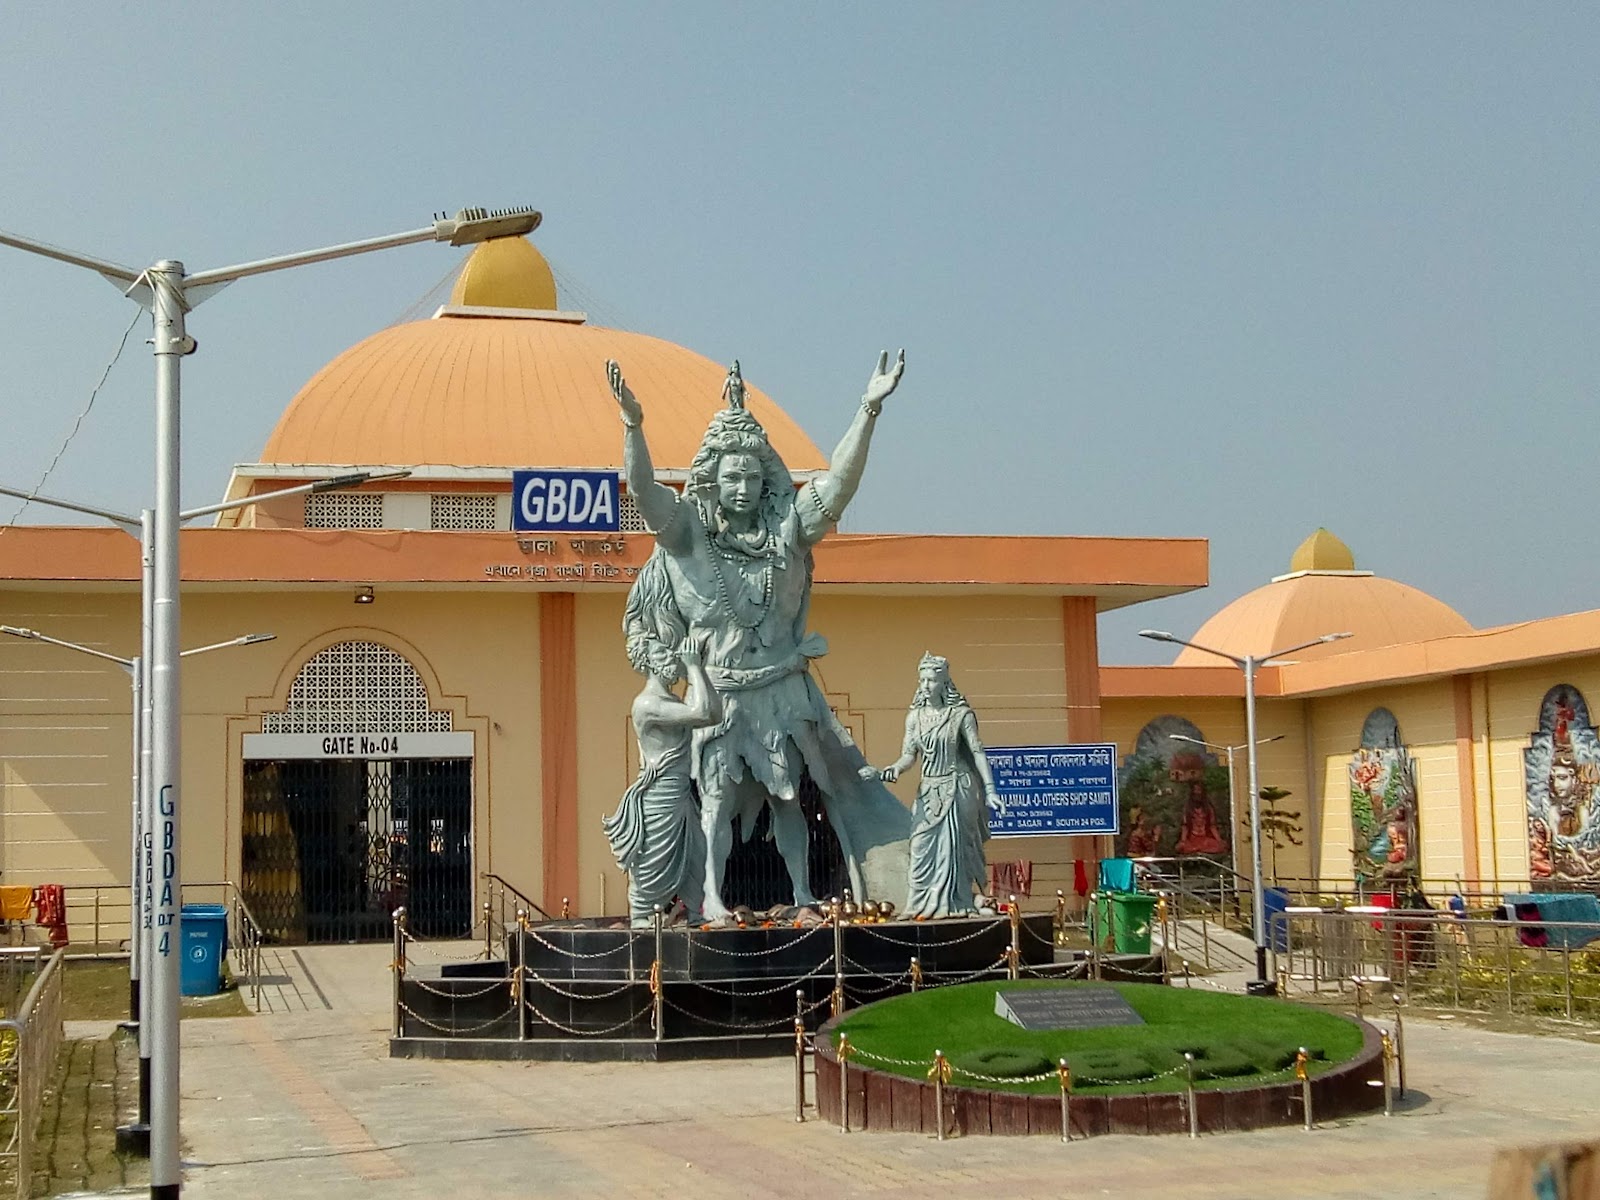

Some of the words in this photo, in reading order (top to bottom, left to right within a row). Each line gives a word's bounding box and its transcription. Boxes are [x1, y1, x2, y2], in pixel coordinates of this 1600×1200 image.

[521, 477, 613, 523] GBDA
[485, 565, 522, 577] এখানে
[525, 565, 548, 580] পূজা
[591, 562, 620, 577] বিক্রি
[323, 737, 354, 754] GATE
[1015, 756, 1022, 767] ও
[1088, 750, 1110, 766] সমিতি
[1042, 792, 1069, 806] OTHERS
[1070, 792, 1088, 806] SHOP
[1089, 792, 1111, 805] SAMITI
[1017, 819, 1042, 828] SAGAR
[1056, 818, 1080, 827] SOUTH
[1081, 818, 1089, 826] 24
[159, 785, 175, 907] GBDA
[158, 932, 170, 957] 4
